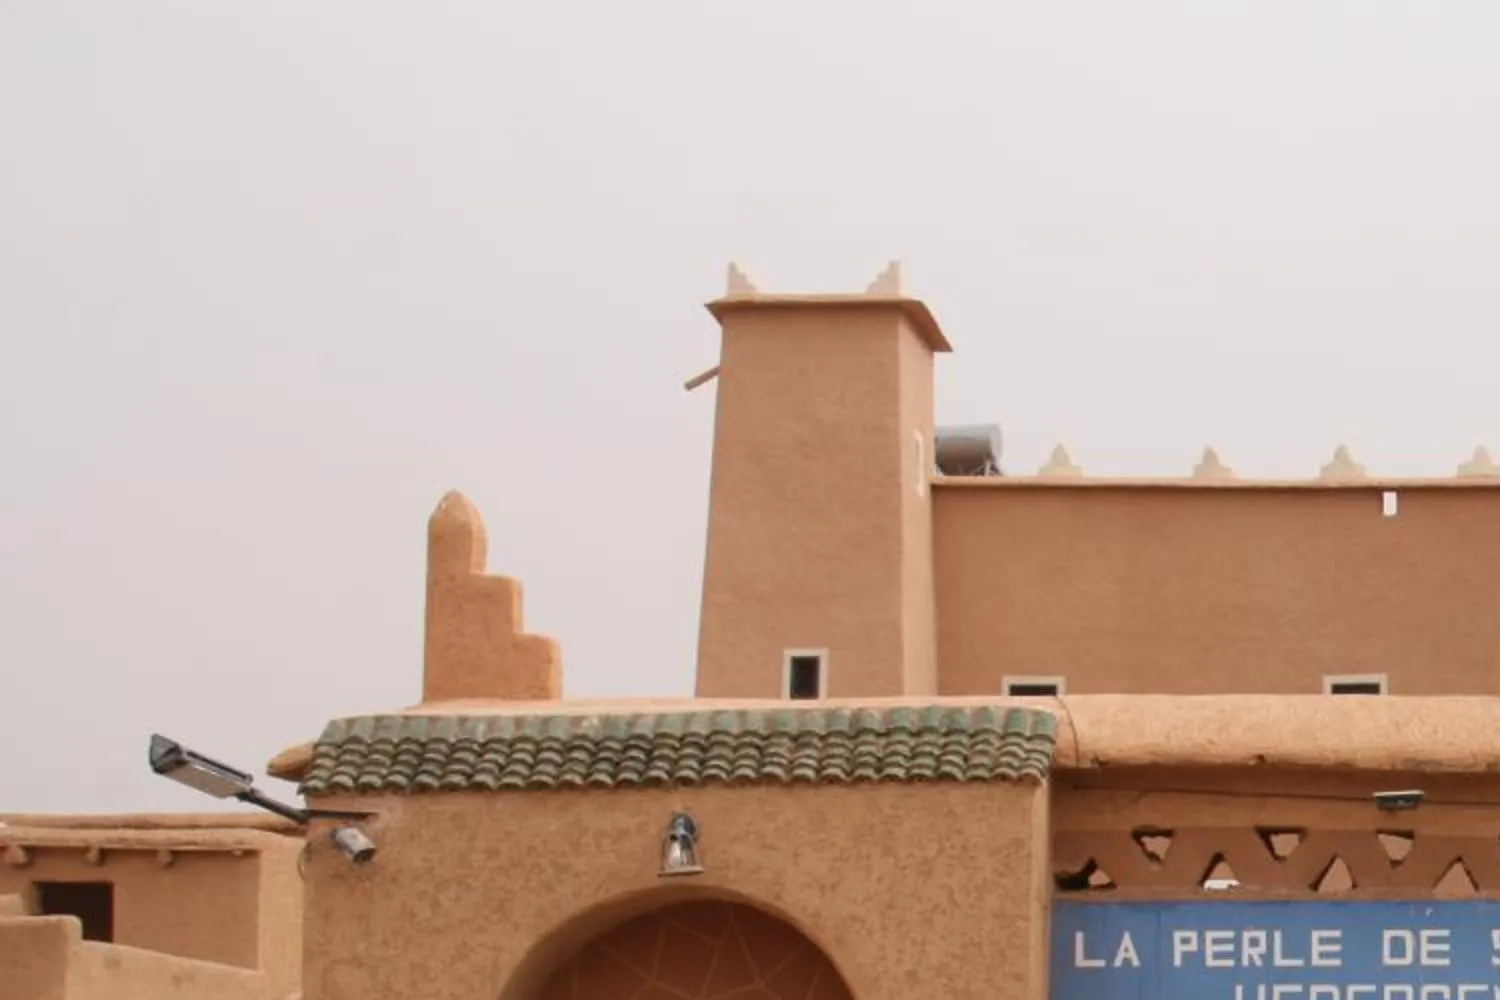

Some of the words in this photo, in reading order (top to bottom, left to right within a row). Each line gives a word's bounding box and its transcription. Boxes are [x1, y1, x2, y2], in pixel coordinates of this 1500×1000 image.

[1074, 930, 1141, 968] LA
[1172, 929, 1343, 967] PERLE
[1382, 928, 1451, 967] DE
